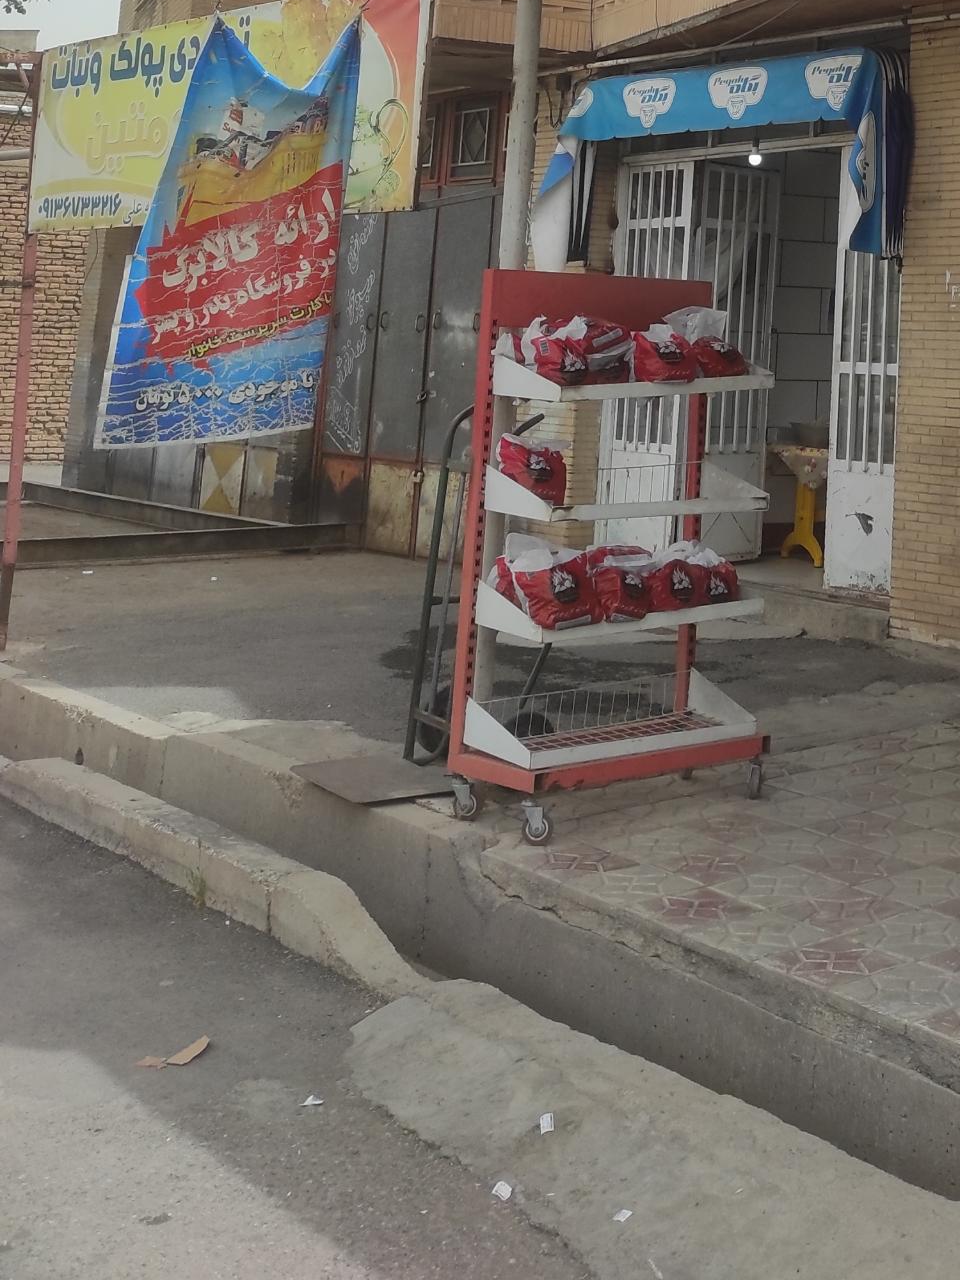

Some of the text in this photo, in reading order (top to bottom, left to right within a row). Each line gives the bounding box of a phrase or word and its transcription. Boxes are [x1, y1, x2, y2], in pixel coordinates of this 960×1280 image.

[109, 36, 166, 98] پولک
[713, 75, 745, 87] Pegah
[812, 64, 846, 76] Pegah
[627, 85, 657, 96] Pegah
[86, 101, 169, 175] متین
[274, 188, 335, 246] ارائه
[236, 255, 311, 306] فروشگاه
[201, 293, 231, 327] پدر
[290, 298, 322, 320] کارت
[152, 310, 180, 345] پسر
